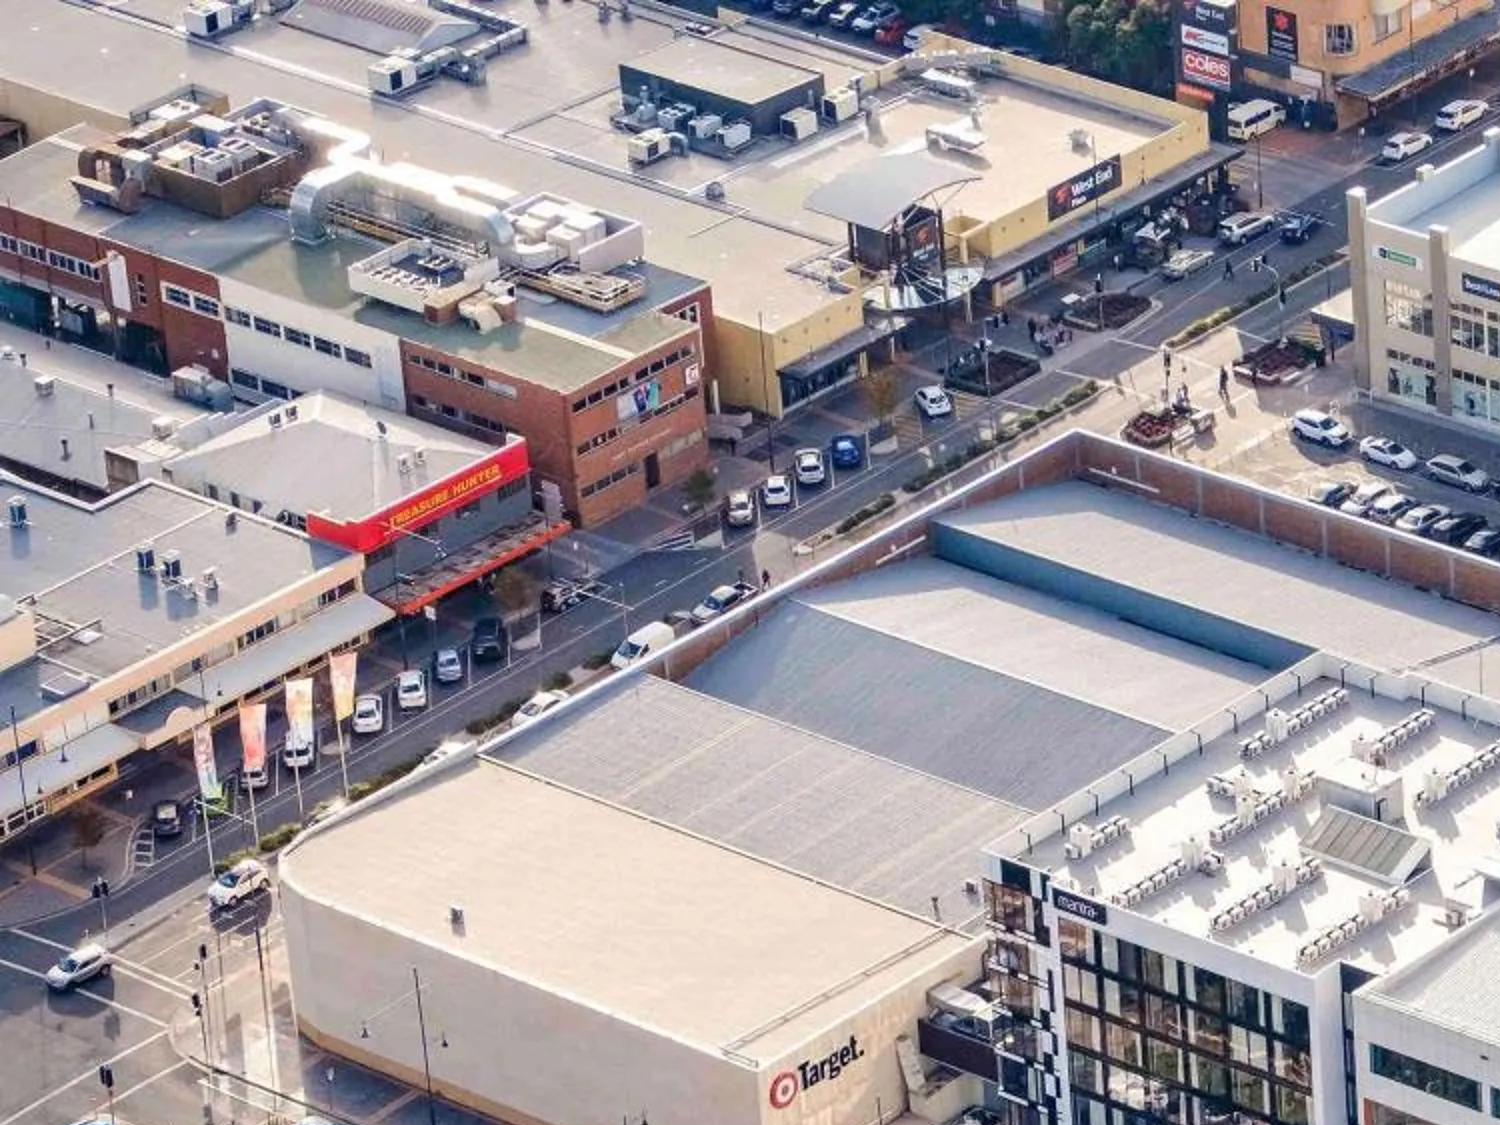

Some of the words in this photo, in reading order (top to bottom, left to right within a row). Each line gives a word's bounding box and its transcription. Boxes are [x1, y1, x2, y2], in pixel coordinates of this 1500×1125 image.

[1184, 53, 1229, 77] coles
[1071, 176, 1094, 197] West
[1095, 165, 1113, 185] End
[452, 463, 501, 497] HUNTER
